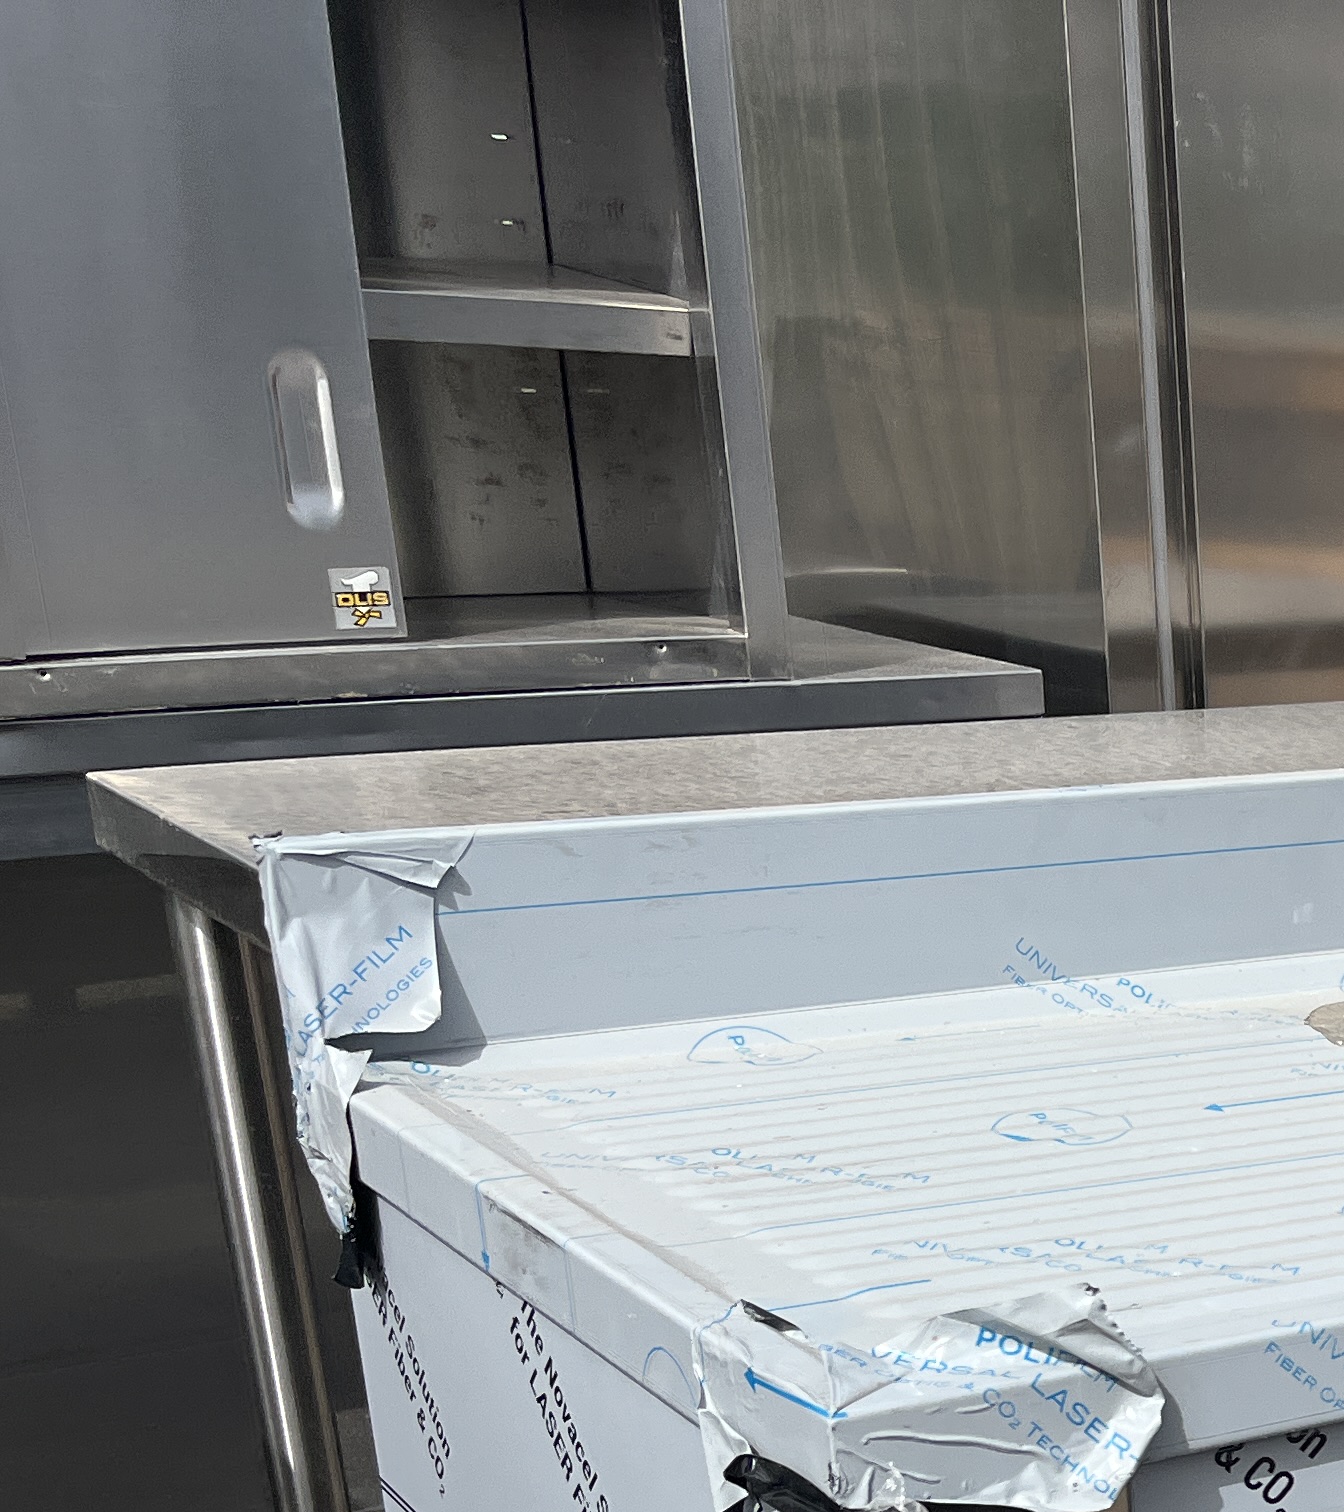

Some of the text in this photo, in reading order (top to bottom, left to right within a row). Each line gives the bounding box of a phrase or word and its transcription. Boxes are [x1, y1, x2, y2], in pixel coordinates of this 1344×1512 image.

[335, 592, 390, 608] OLIS
[387, 1325, 417, 1402] Fiber
[416, 1408, 427, 1433] &
[405, 1333, 451, 1459] Solution
[509, 1316, 531, 1366] for
[528, 1368, 574, 1483] LASER
[520, 1300, 545, 1356] The
[543, 1355, 599, 1492] Novacel
[1262, 1339, 1318, 1393] FIBER
